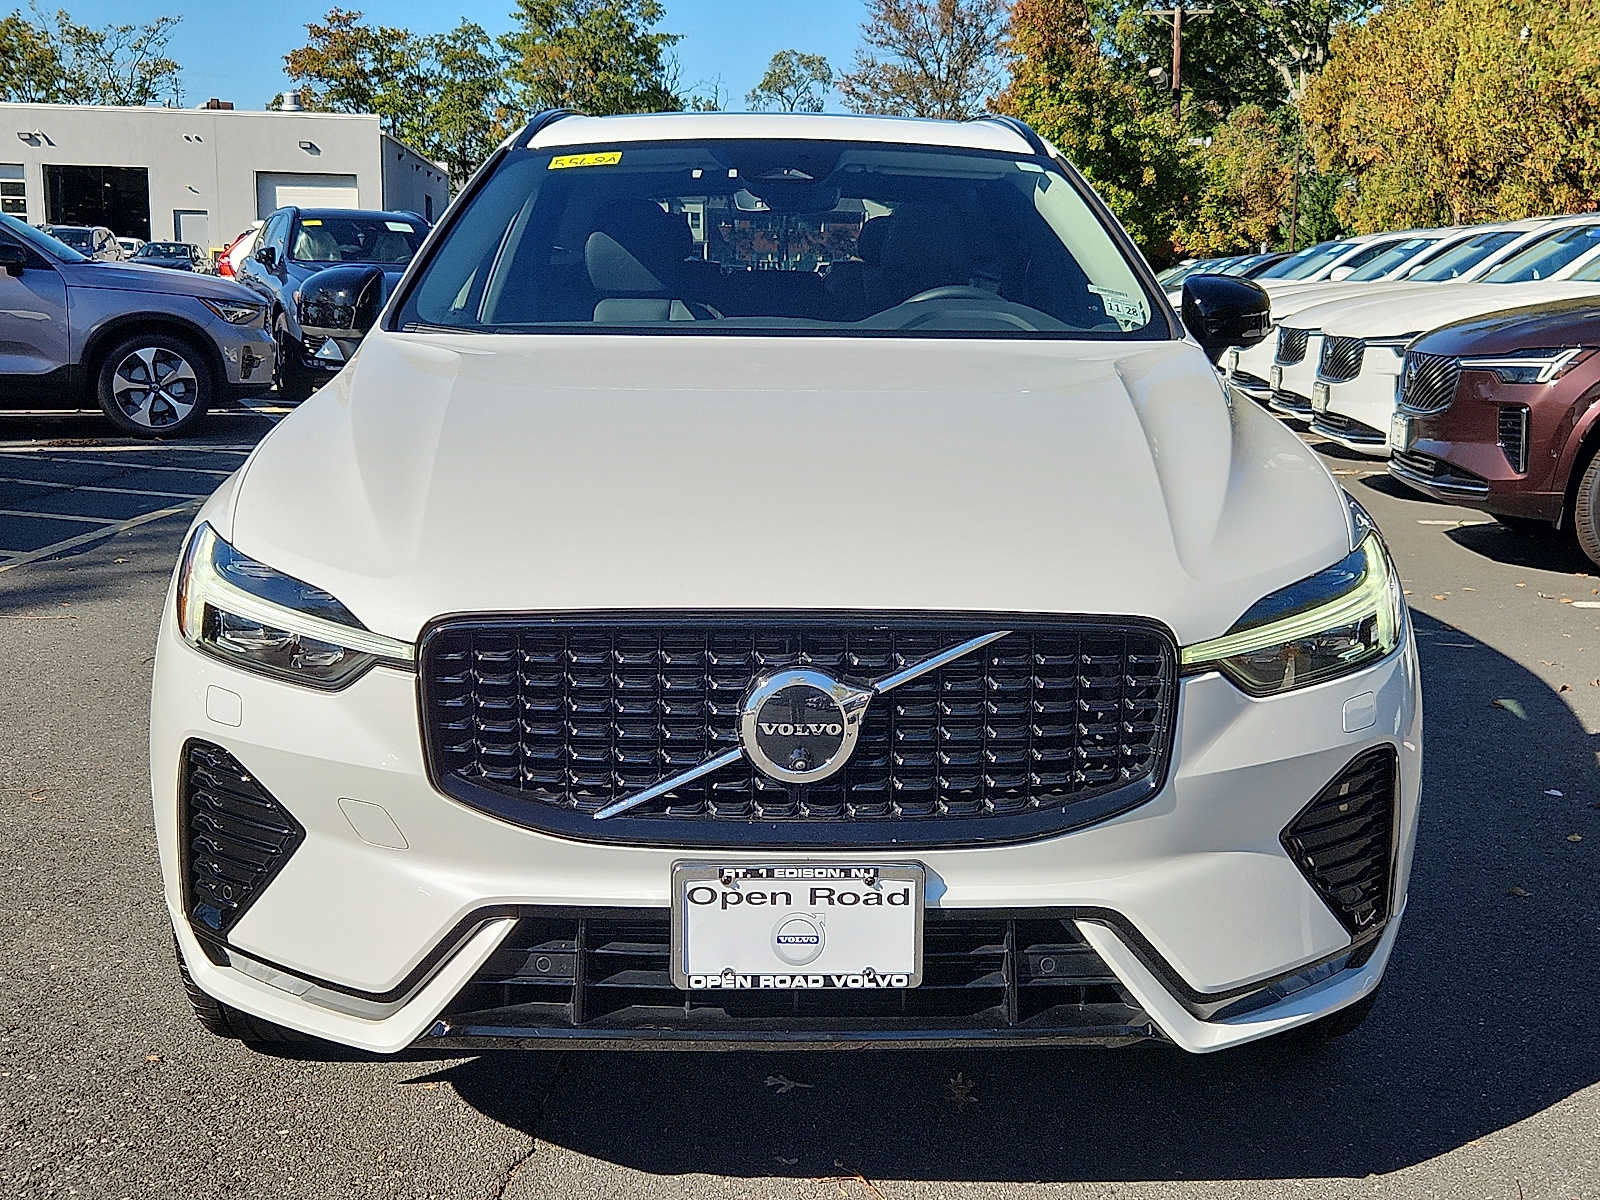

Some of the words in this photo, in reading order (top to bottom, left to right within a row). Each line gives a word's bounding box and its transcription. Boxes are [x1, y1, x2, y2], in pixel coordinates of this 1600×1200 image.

[758, 723, 842, 736] VOLVO
[851, 868, 875, 879] NJ
[687, 886, 792, 910] Open
[809, 887, 910, 906] Road
[778, 936, 819, 944] VOLVO
[689, 975, 752, 989] OPEN
[760, 975, 825, 989] ROAD
[831, 975, 909, 989] VOLVO
